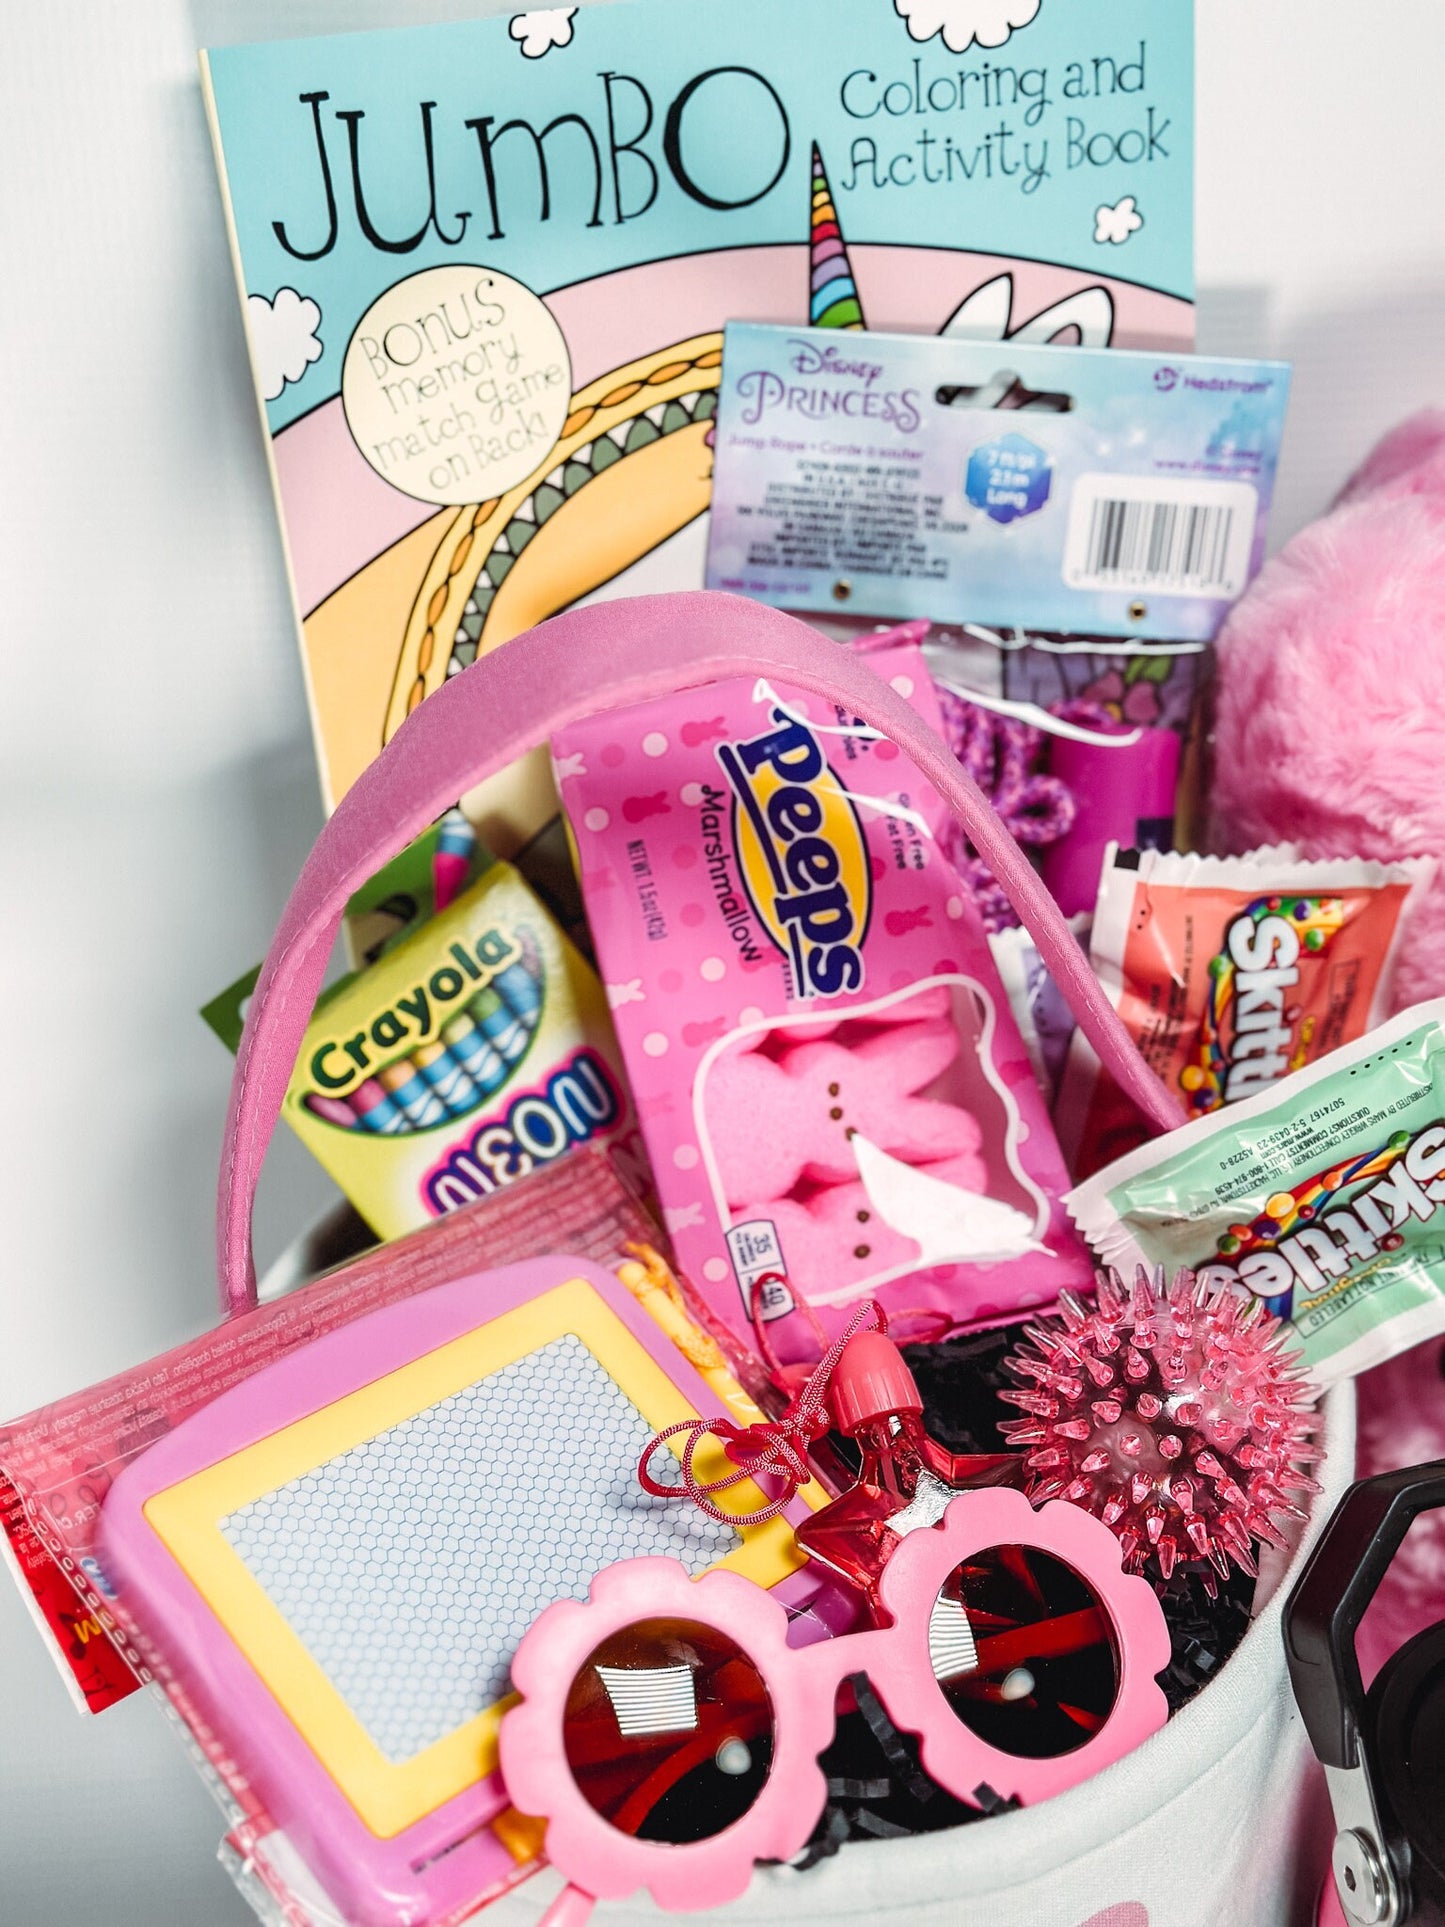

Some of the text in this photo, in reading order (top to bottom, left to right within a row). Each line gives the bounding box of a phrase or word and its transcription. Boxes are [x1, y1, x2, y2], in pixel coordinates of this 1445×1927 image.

[841, 41, 1145, 126] Coloring and
[841, 107, 1170, 195] Activity Book
[381, 332, 525, 414] memory
[373, 364, 565, 470] match game
[429, 451, 470, 489] on
[892, 839, 907, 870] Free
[911, 839, 925, 870] Free
[700, 784, 763, 963] Marshmallow
[310, 929, 513, 1089] Crayola
[1224, 916, 1299, 1107] Skittl
[1308, 1096, 1344, 1122] 5074167
[1366, 1109, 1386, 1126] MARS
[1385, 1104, 1396, 1116] BY
[1255, 1117, 1306, 1150] 5-2-0439-23
[1260, 1125, 1313, 1159] www.mars.com
[1340, 1119, 1367, 1141] WRIGLEY
[1215, 1105, 1370, 1195] QUESTIONS? COMMENTS? CALL 1-800-974-4539
[1291, 1134, 1340, 1167] CONFECTIONERY
[754, 1234, 773, 1254] 35
[1308, 1290, 1355, 1327] LABELED
